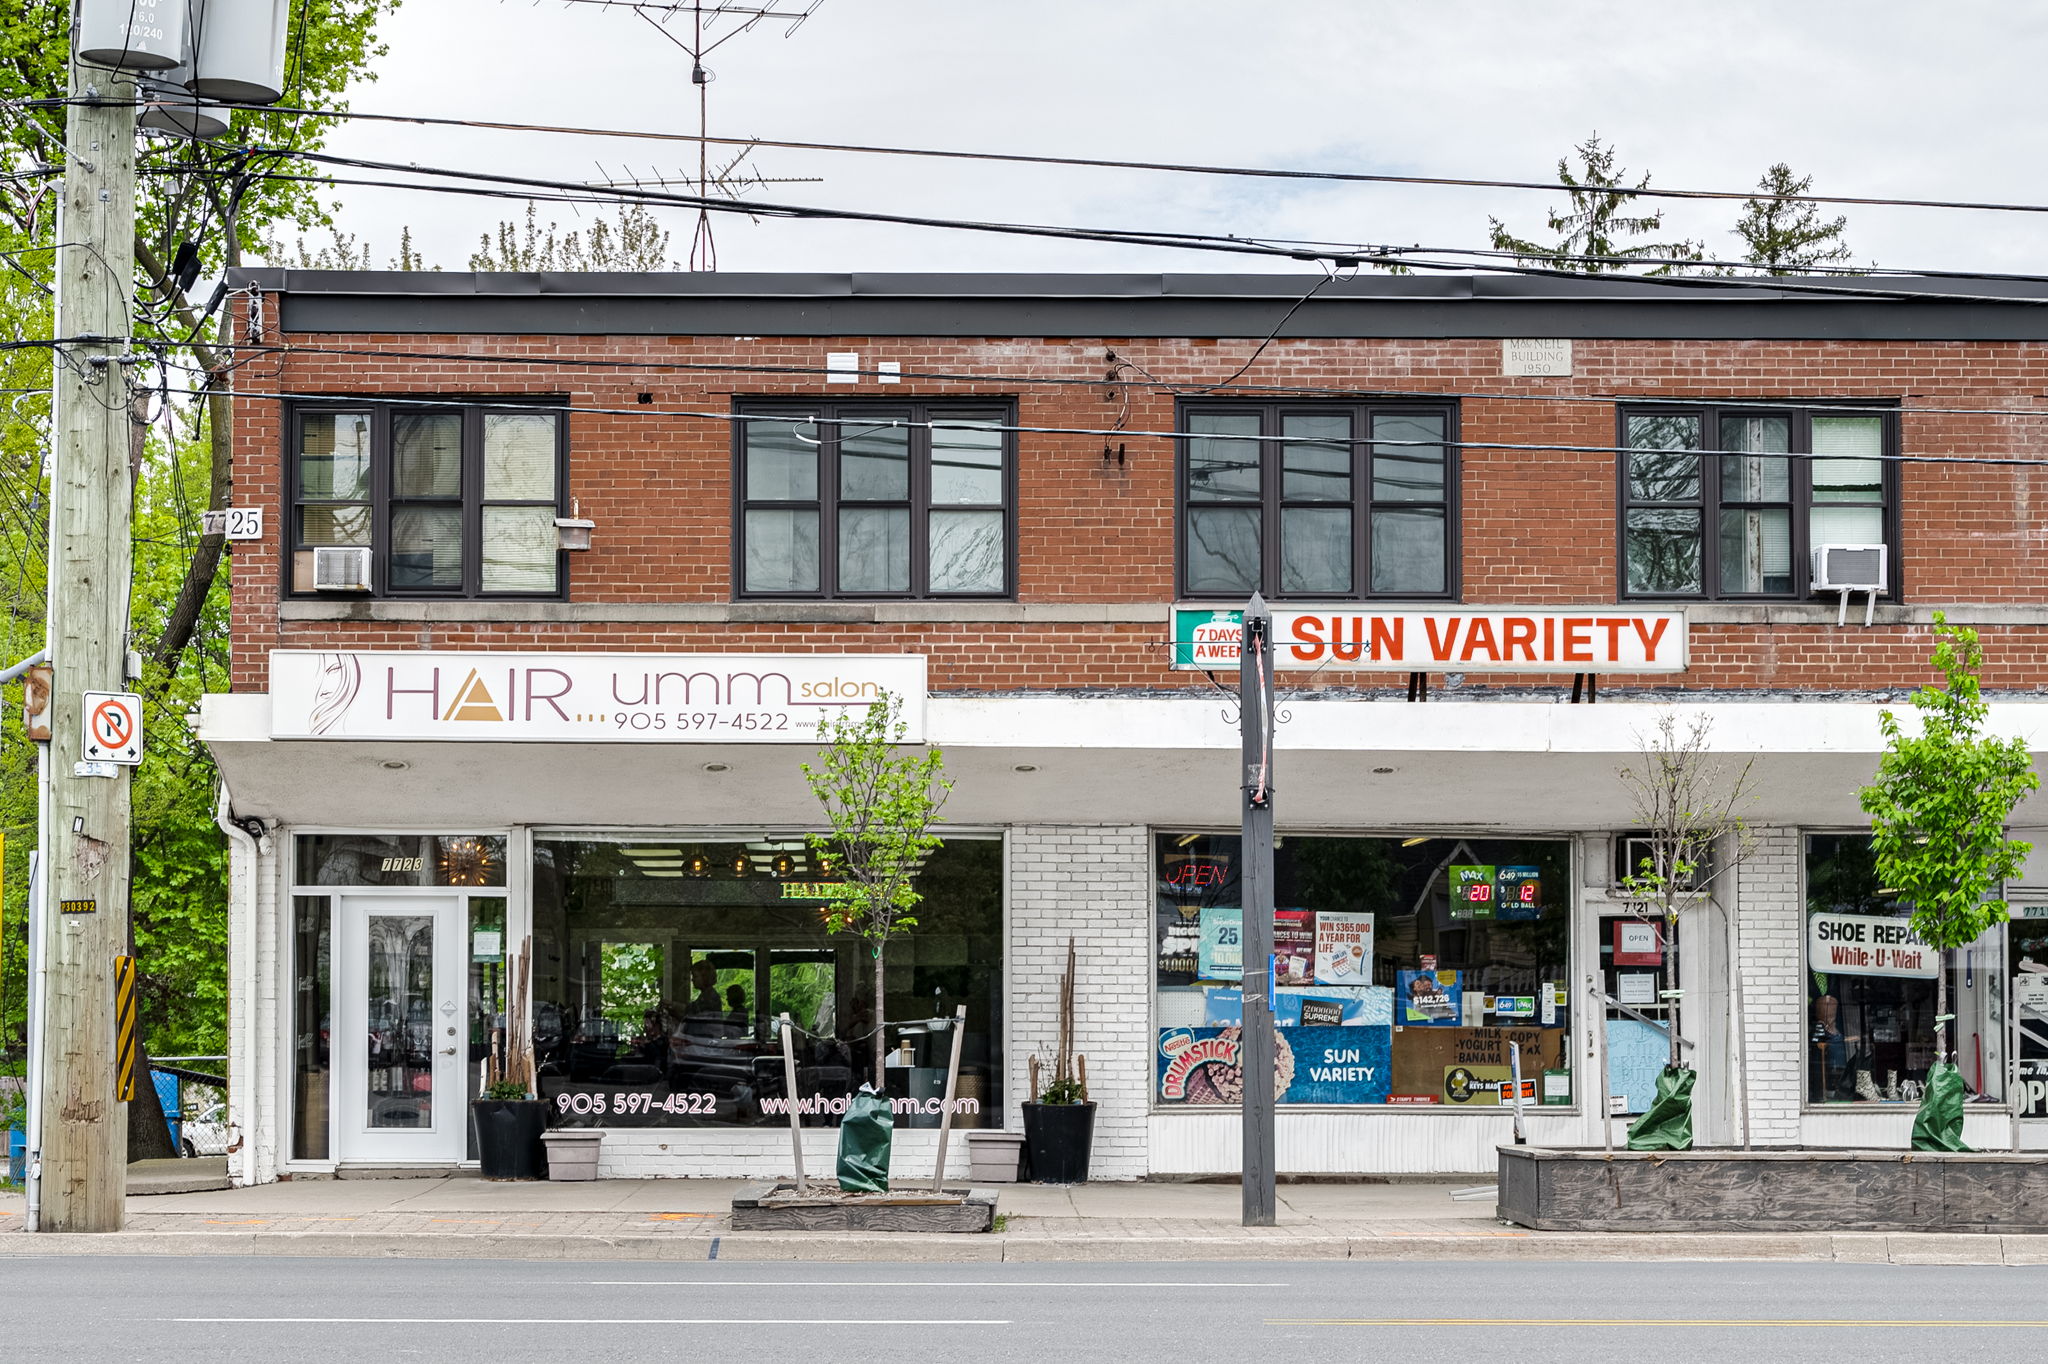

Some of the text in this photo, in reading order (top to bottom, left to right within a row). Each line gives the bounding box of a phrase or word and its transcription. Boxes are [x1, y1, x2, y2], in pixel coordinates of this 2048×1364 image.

[1511, 351, 1564, 362] BUILDING
[1523, 363, 1551, 374] 1950
[1196, 629, 1243, 641] 7 DAYS
[1290, 615, 1671, 662] SUN VARIETY
[1195, 645, 1206, 658] A
[800, 676, 879, 698] salon
[614, 712, 789, 730] 905 597-4522
[382, 857, 423, 871] 7723
[1469, 884, 1491, 902] 20
[1520, 884, 1535, 902] 12
[60, 901, 96, 912] P30392
[1167, 926, 1200, 937] BIGG
[1319, 922, 1335, 932] WIN
[1817, 920, 1929, 947] SHOE REPA
[1218, 927, 1239, 945] 25
[1318, 933, 1361, 943] A YEAR FOR
[1628, 934, 1649, 942] OPEN
[1318, 943, 1334, 953] LIFE
[1302, 1012, 1340, 1023] SUPREME
[1474, 1028, 1540, 1042] MILK COPY
[1459, 1039, 1501, 1052] YOGURT
[1323, 1048, 1360, 1064] SUN
[1458, 1052, 1501, 1064] BANANA
[1163, 1040, 1236, 1099] DRUMSTICK
[1309, 1067, 1375, 1082] VARIETY
[1469, 1082, 1499, 1090] KEYS MAD
[557, 1092, 717, 1115] 905 597-4522
[759, 1092, 980, 1115] www.haim.cm
